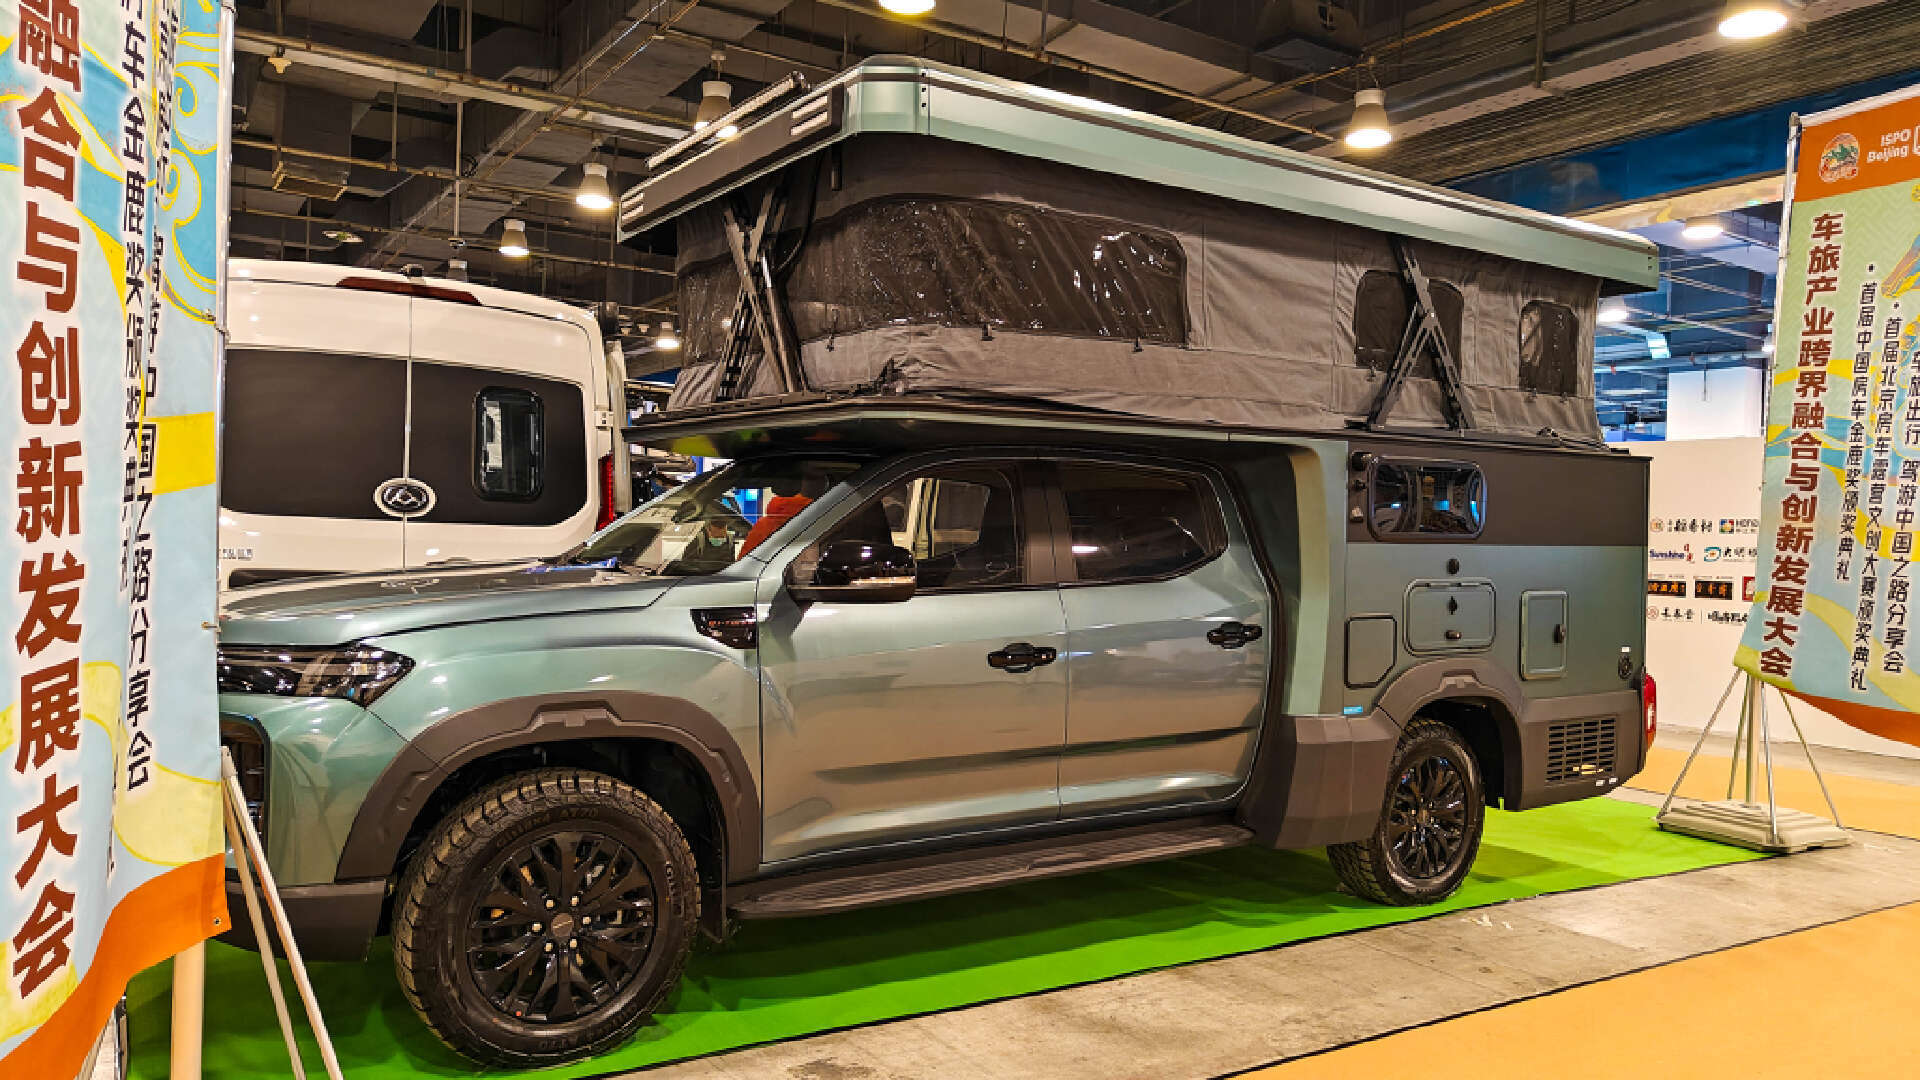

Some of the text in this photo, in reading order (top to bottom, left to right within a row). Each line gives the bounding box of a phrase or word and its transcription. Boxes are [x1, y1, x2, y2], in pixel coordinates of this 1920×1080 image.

[1881, 129, 1911, 147] ISPO
[1866, 145, 1909, 163] Beijing
[1760, 213, 1844, 678] 车旅产业跨界融合与创新发展大会
